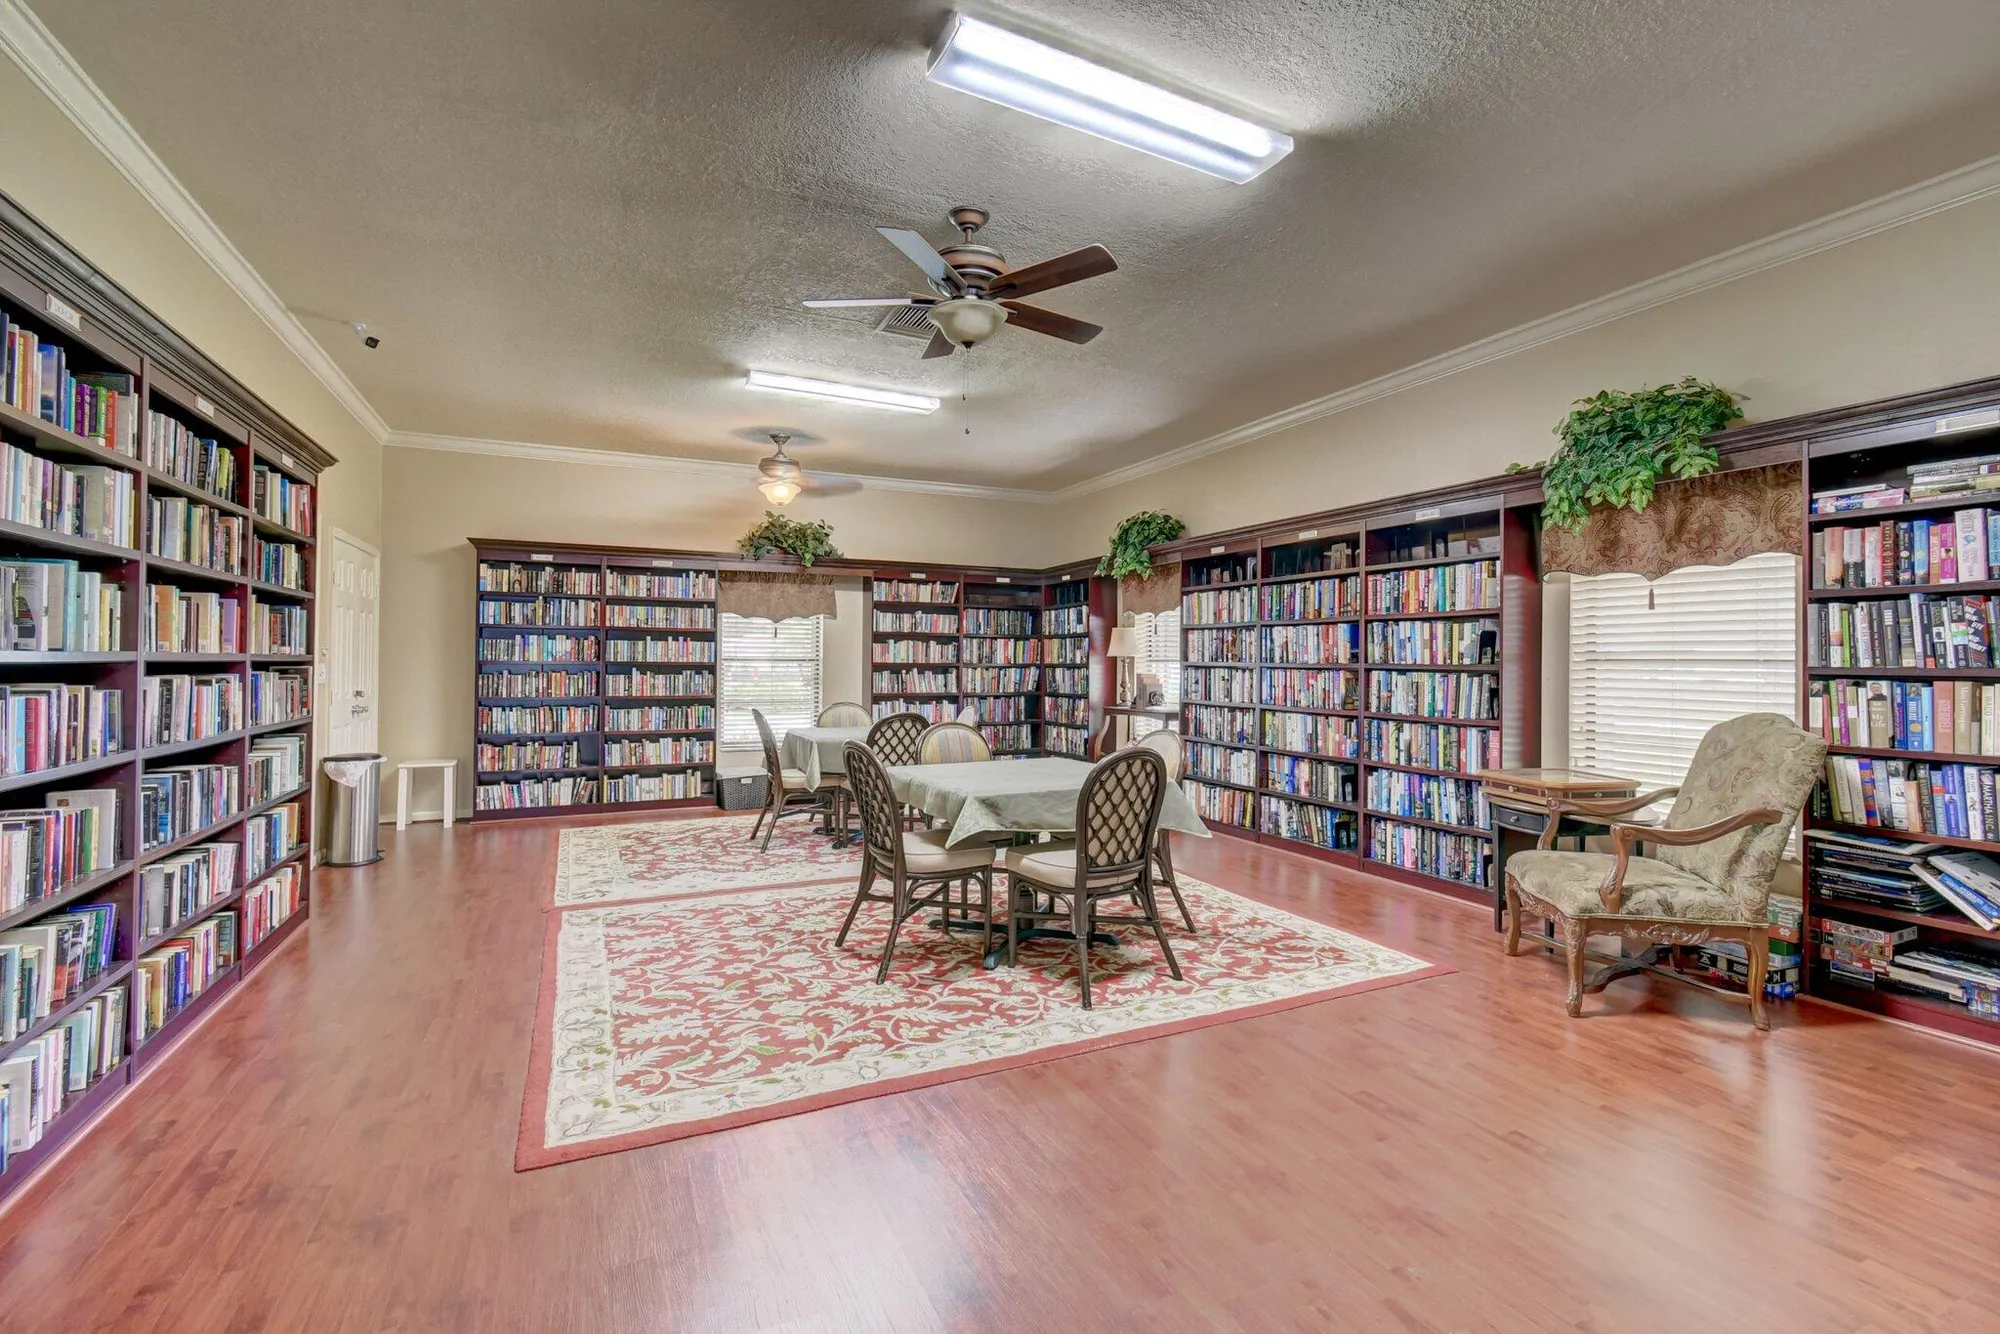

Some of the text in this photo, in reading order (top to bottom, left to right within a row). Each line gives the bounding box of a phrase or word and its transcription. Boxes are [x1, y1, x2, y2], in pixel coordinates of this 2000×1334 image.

[1971, 621, 1984, 630] UTE
[1871, 713, 1884, 721] My
[1870, 720, 1887, 728] Life
[1982, 784, 1995, 831] MARTHA INC.
